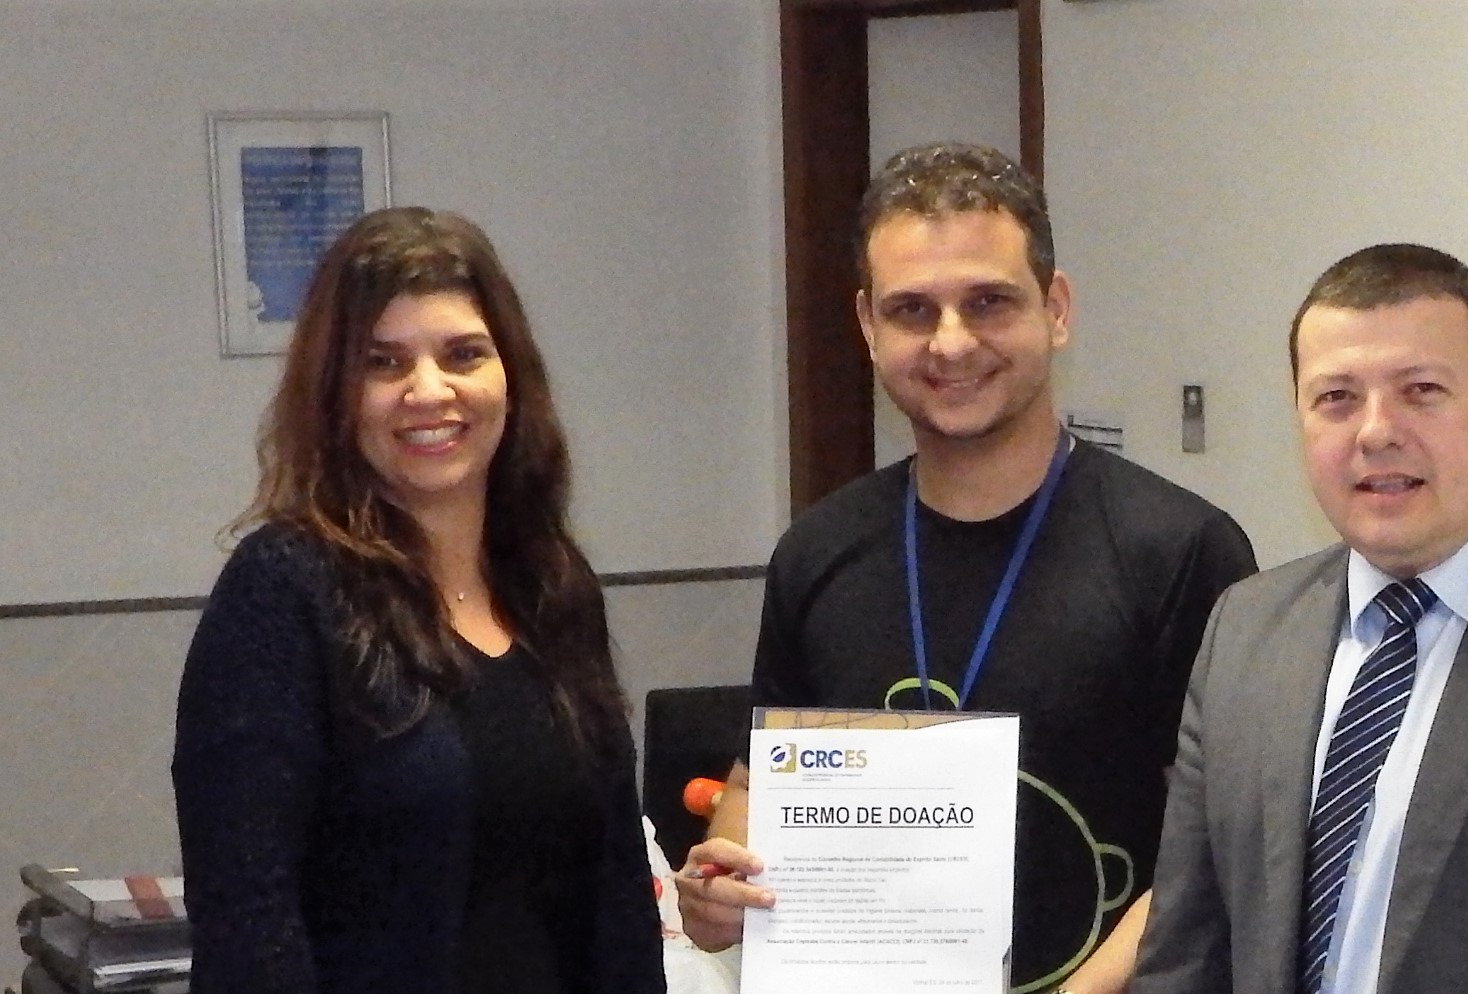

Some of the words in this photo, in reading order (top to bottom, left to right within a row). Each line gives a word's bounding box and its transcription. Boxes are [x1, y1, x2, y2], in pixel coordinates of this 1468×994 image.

[800, 749, 868, 769] CRCES
[780, 806, 850, 825] TERMO
[857, 806, 883, 825] DE
[889, 802, 974, 828] DOAÇÃO
